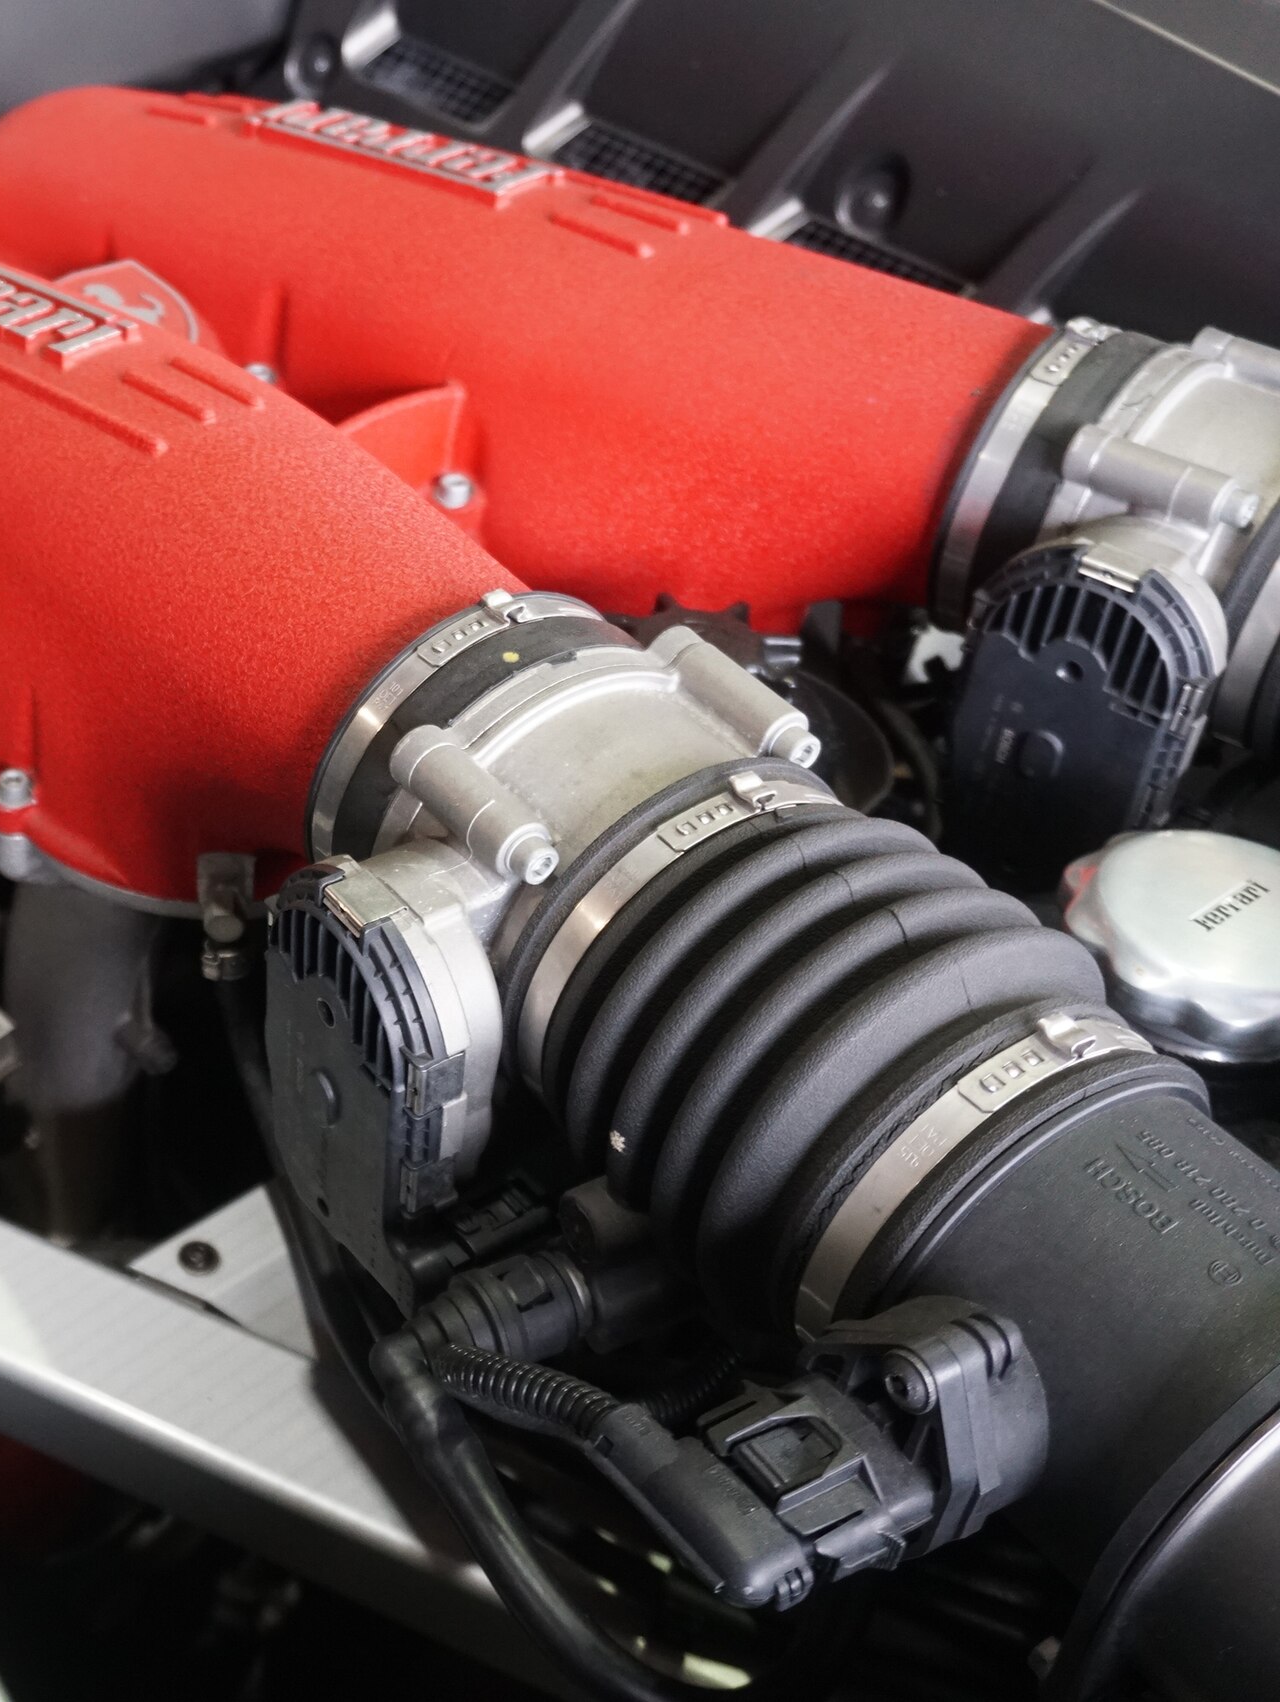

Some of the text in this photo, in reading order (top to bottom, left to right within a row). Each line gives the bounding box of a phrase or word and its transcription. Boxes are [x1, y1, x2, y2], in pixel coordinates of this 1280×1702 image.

[248, 101, 550, 198] Ferrari
[1188, 879, 1271, 932] Ferrari
[1084, 1157, 1180, 1235] BOSCH
